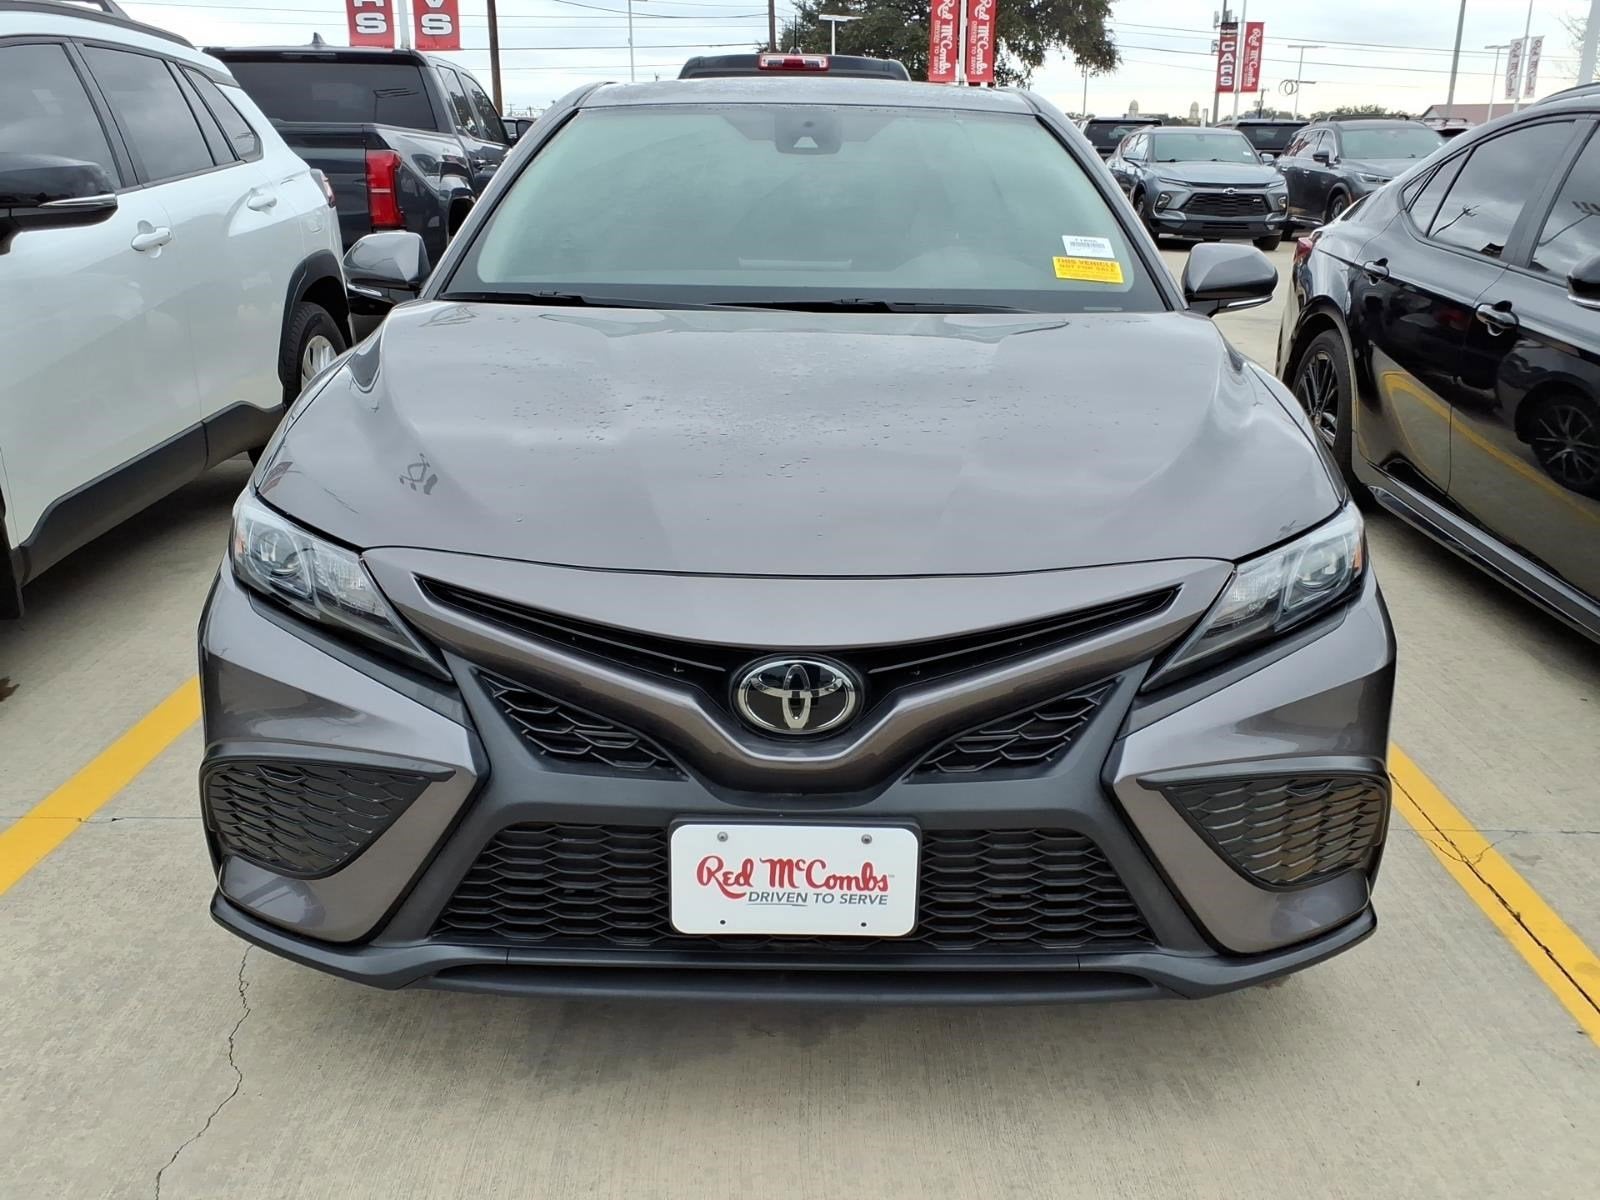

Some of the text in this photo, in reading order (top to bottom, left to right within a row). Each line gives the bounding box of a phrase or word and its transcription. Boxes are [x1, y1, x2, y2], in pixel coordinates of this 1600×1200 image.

[934, 46, 940, 54] TO
[939, 22, 953, 75] McCombs
[971, 46, 977, 55] TO
[976, 22, 989, 75] McCombs
[1248, 28, 1261, 47] Red
[1220, 41, 1236, 86] CARS
[1247, 48, 1259, 87] McCombs
[696, 855, 889, 899] Red McCombs
[748, 891, 889, 905] DRIVEN TO SERVE
